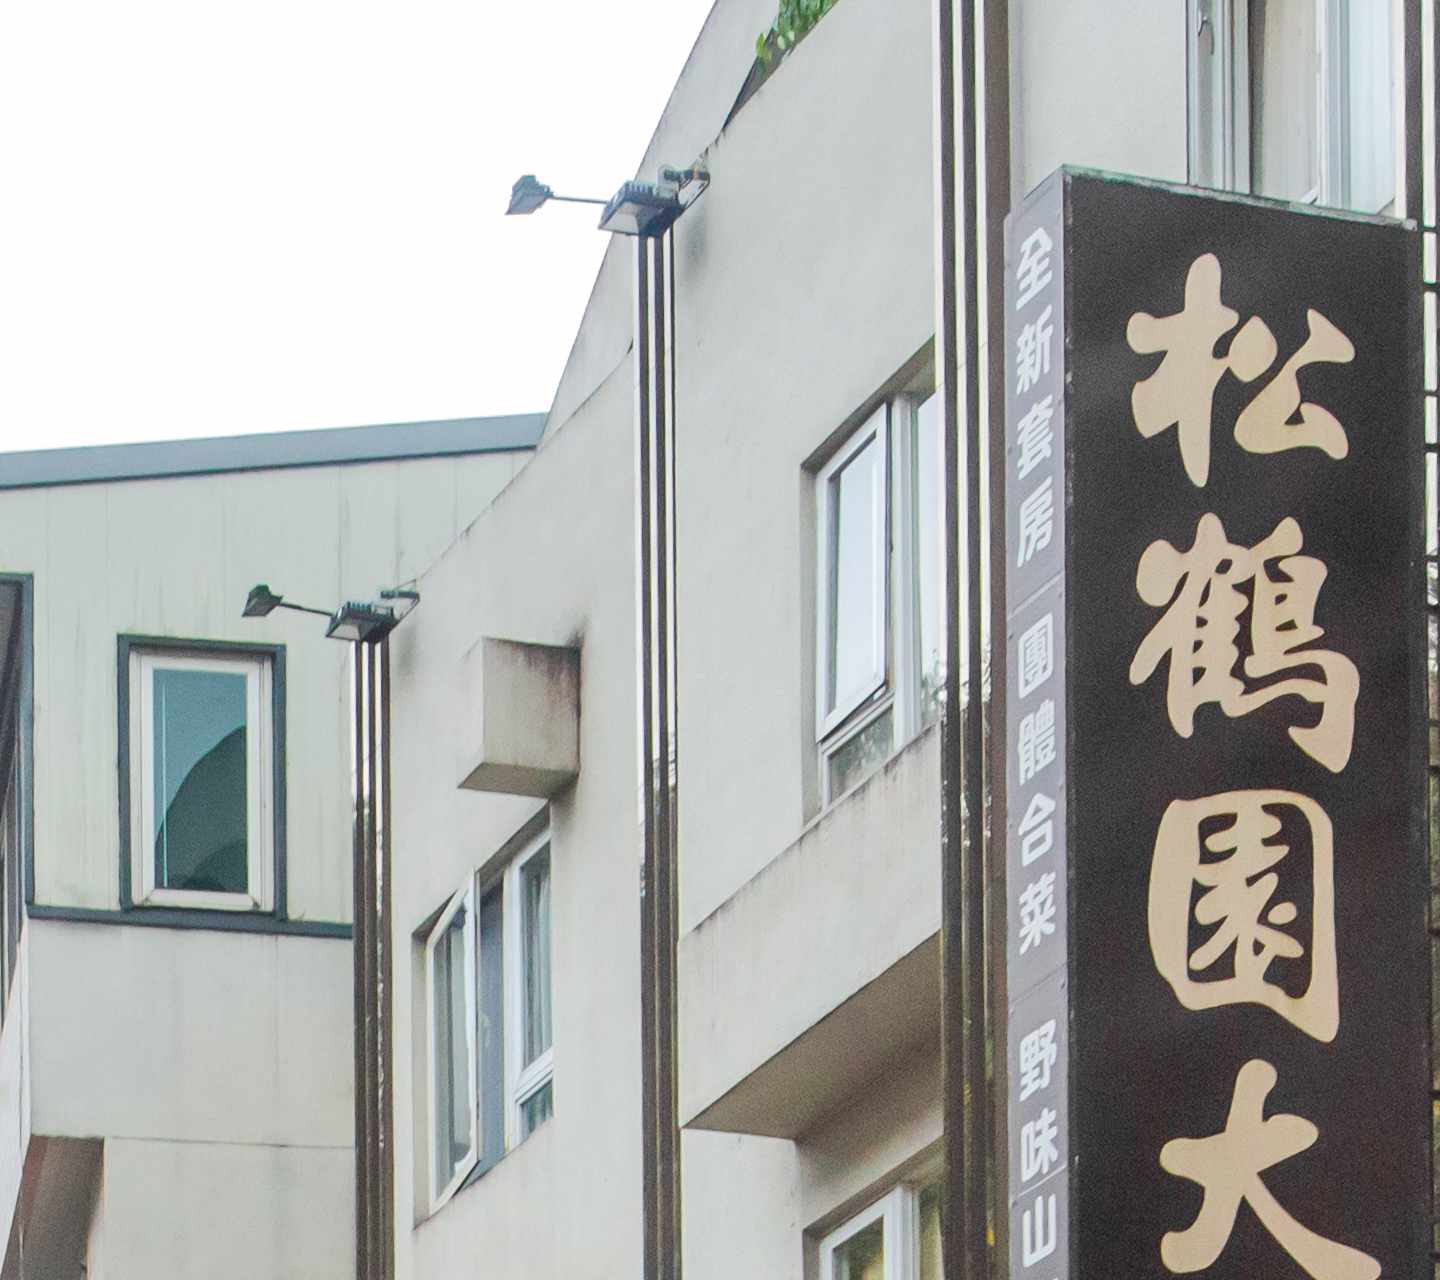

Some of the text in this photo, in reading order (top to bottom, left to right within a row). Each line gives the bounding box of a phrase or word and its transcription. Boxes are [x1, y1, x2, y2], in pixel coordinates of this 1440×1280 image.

[1016, 225, 1054, 568] 全新套房
[1017, 613, 1056, 950] 團體合菜
